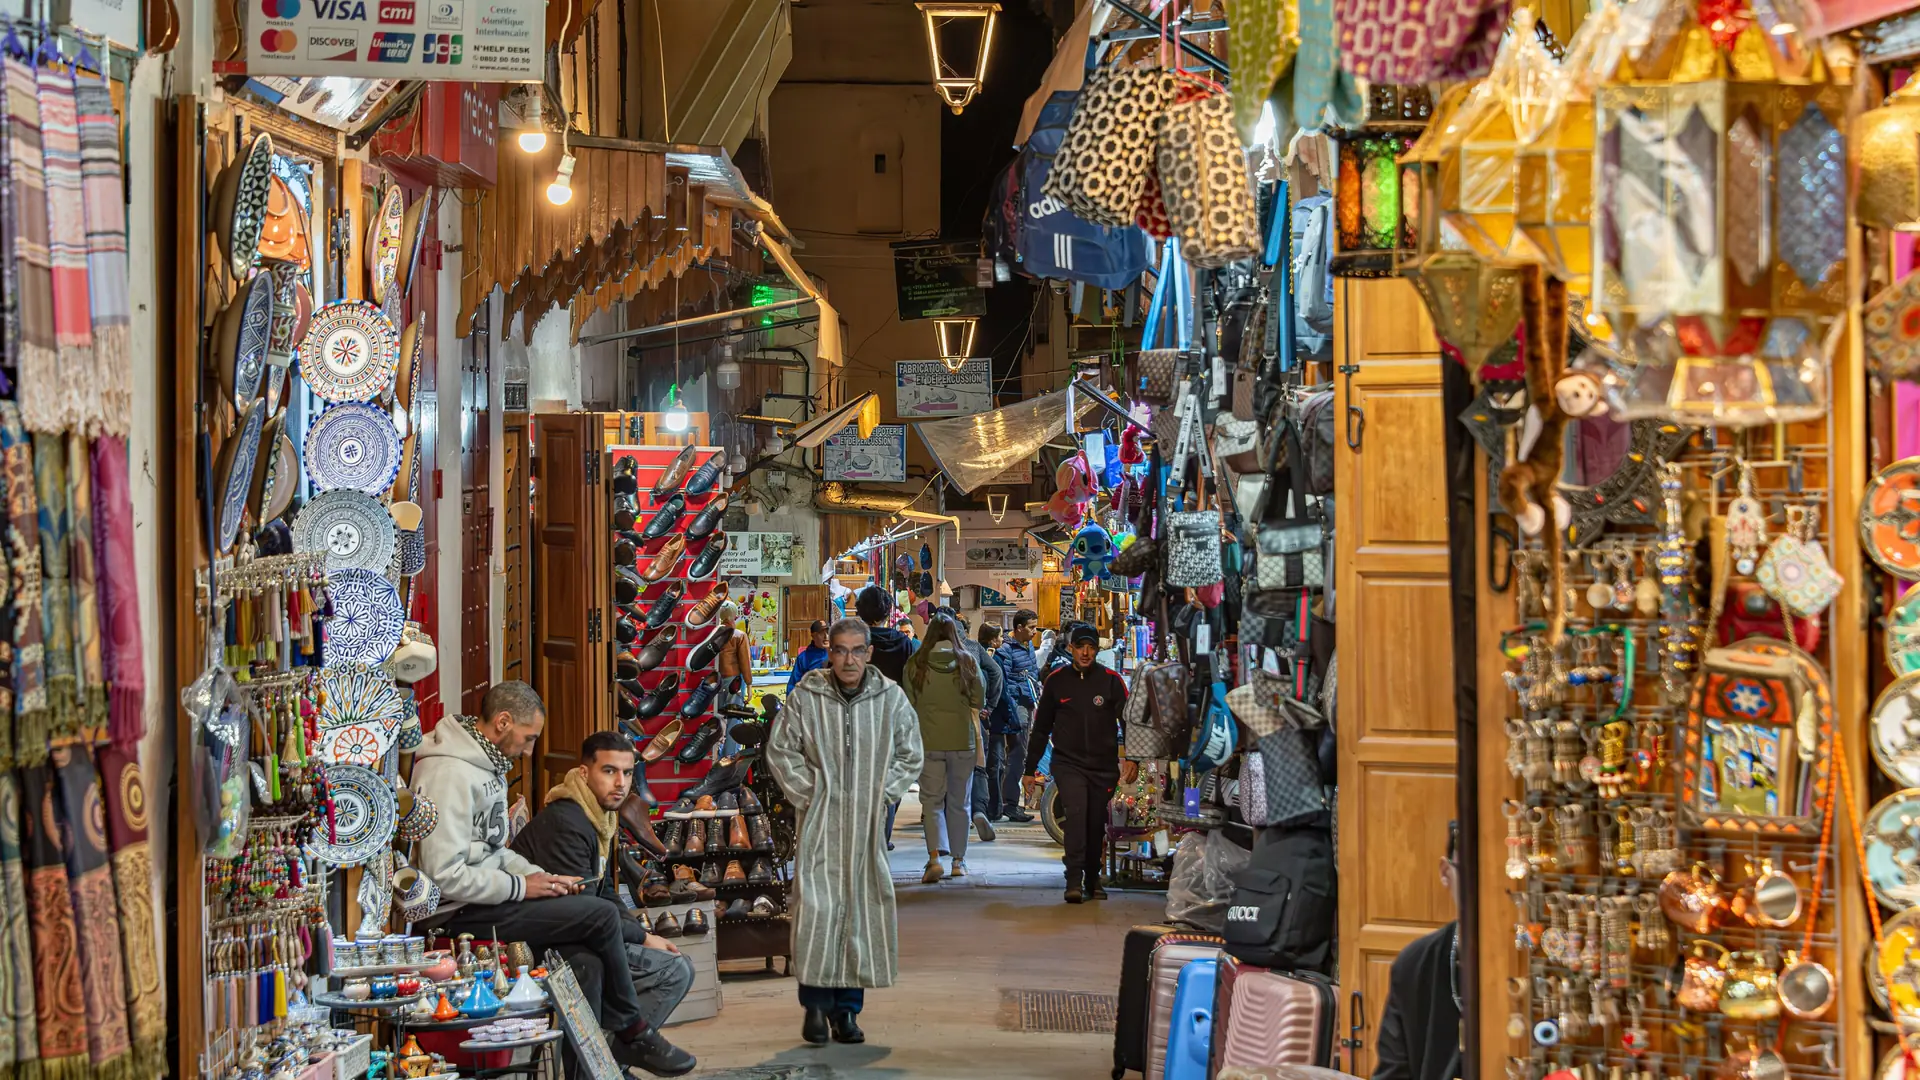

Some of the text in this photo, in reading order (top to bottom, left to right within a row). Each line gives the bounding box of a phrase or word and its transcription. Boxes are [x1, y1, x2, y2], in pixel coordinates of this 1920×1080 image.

[311, 0, 367, 21] VISA
[381, 4, 413, 20] cmi
[490, 5, 518, 15] Centre
[266, 19, 295, 27] maestro
[310, 36, 355, 47] DISCOVER
[372, 38, 412, 51] UnionPay
[423, 43, 462, 56] JCB
[507, 46, 530, 54] DESK
[260, 53, 296, 61] mastercard
[1203, 722, 1226, 760] NIKE
[1227, 905, 1261, 922] GUCCI
